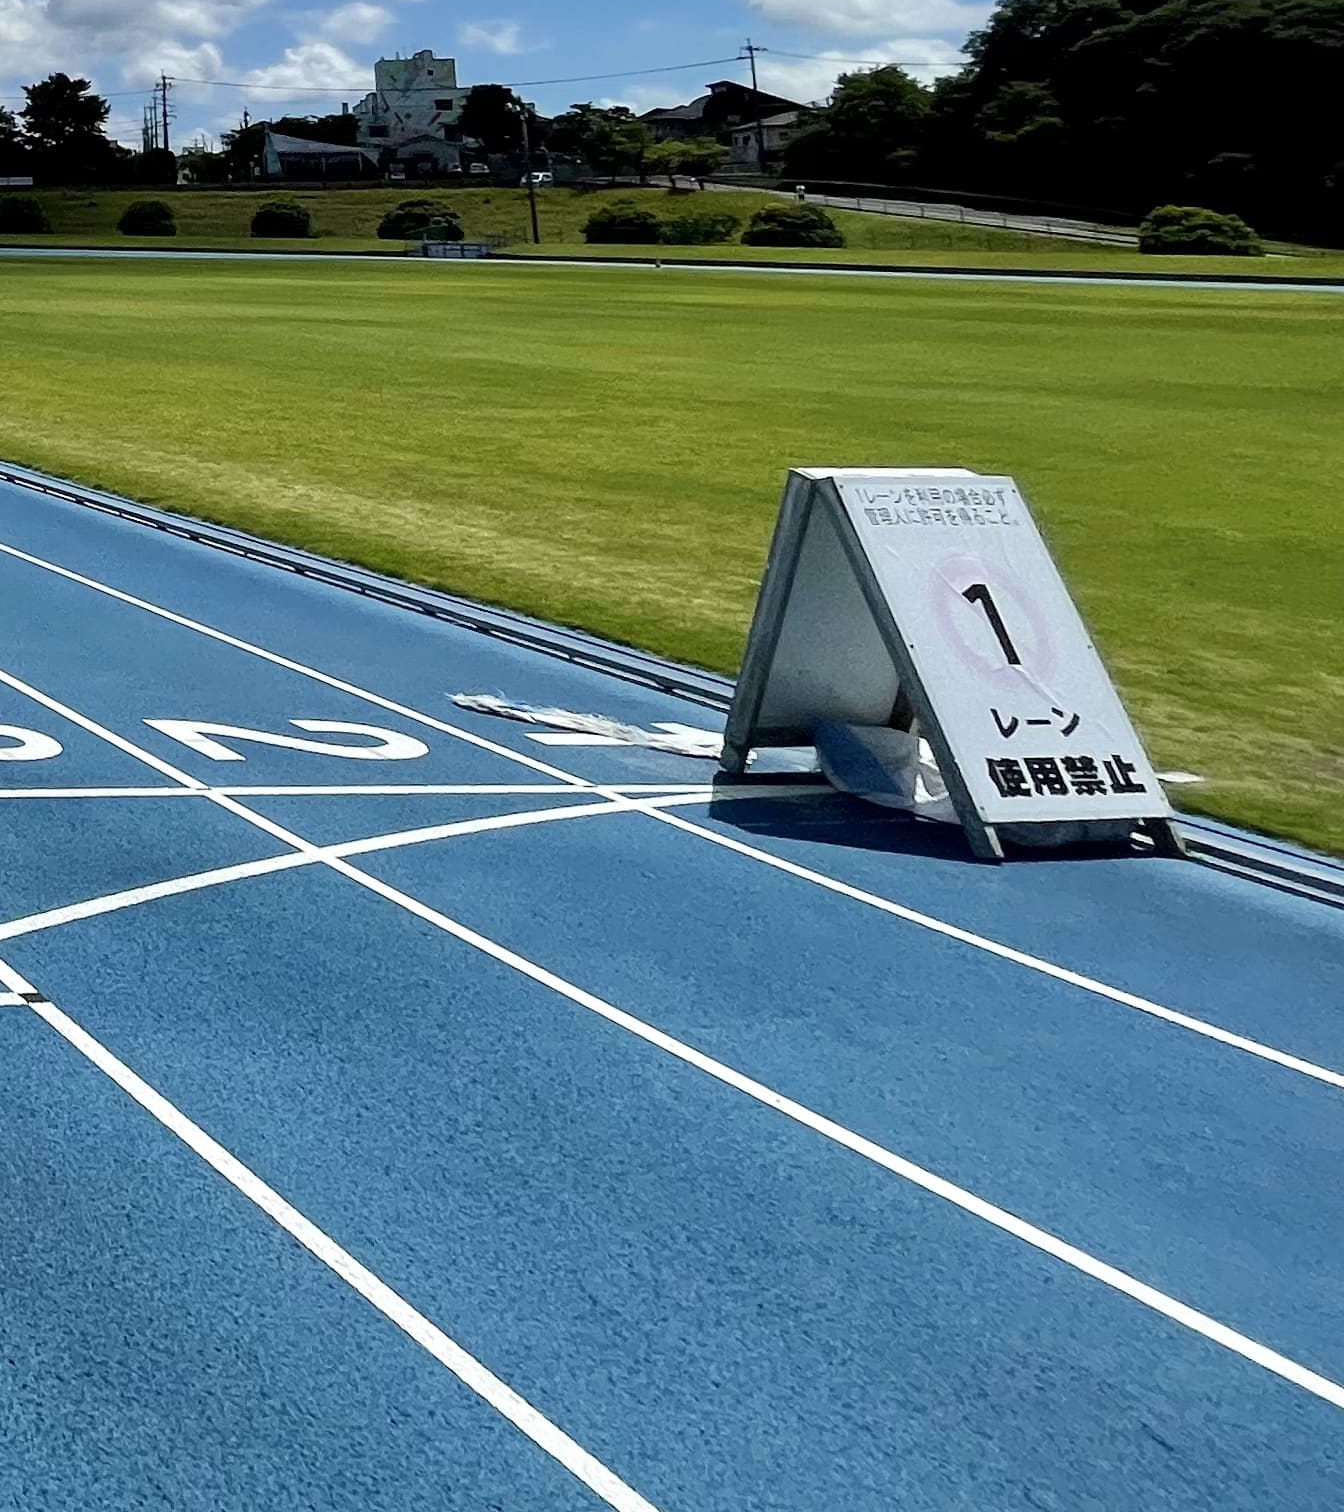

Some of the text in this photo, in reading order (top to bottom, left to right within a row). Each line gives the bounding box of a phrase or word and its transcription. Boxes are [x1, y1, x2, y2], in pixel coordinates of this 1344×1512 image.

[962, 584, 1022, 665] 1
[142, 719, 430, 761] 2
[990, 708, 1081, 738] レーン
[985, 754, 1147, 797] 使用禁止
